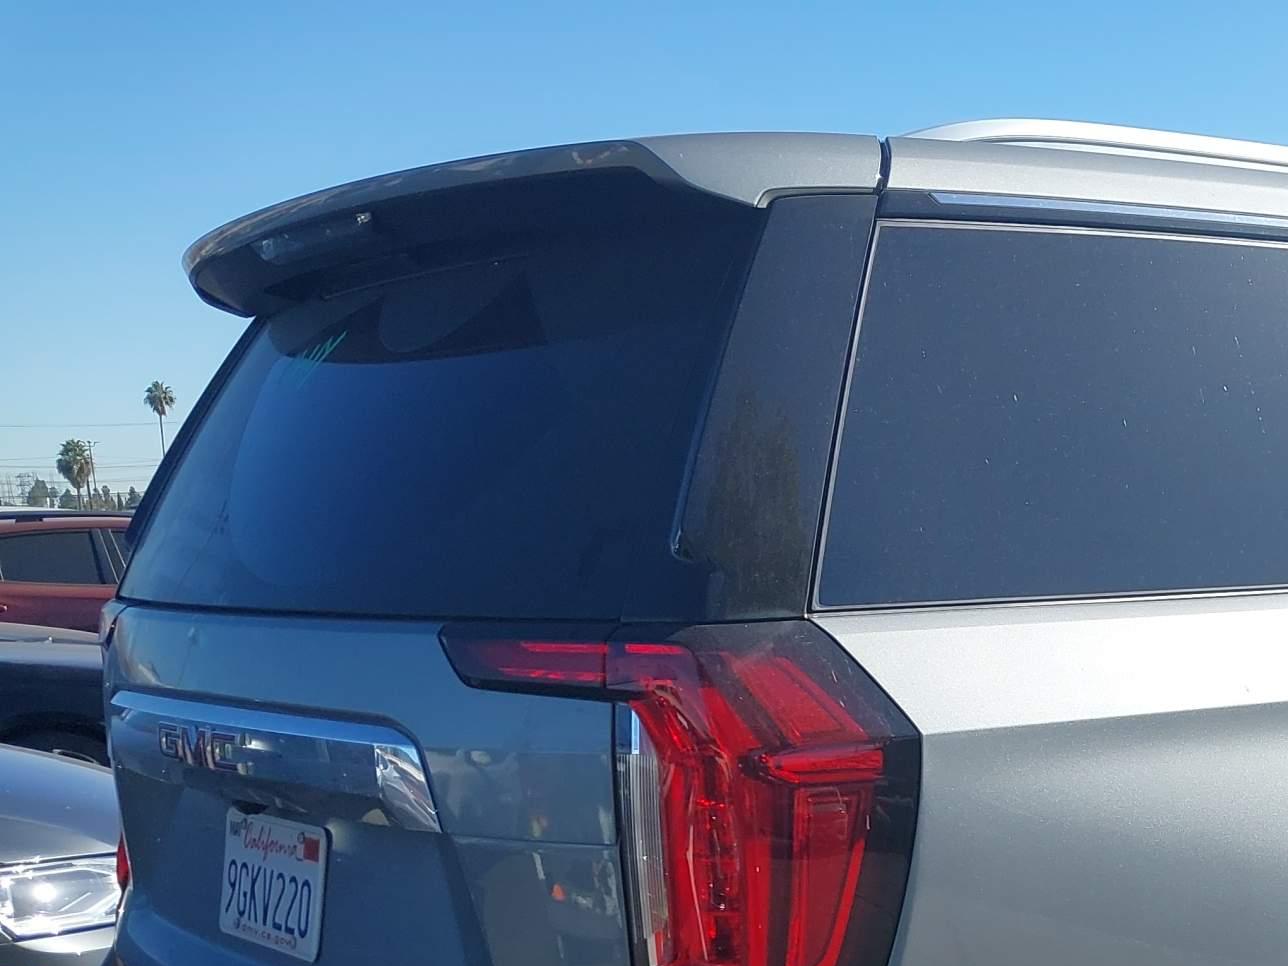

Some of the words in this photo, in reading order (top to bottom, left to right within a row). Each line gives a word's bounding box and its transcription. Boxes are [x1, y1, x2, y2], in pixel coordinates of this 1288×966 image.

[157, 721, 239, 774] GMC
[243, 820, 298, 862] California
[225, 858, 312, 939] 9GKV220
